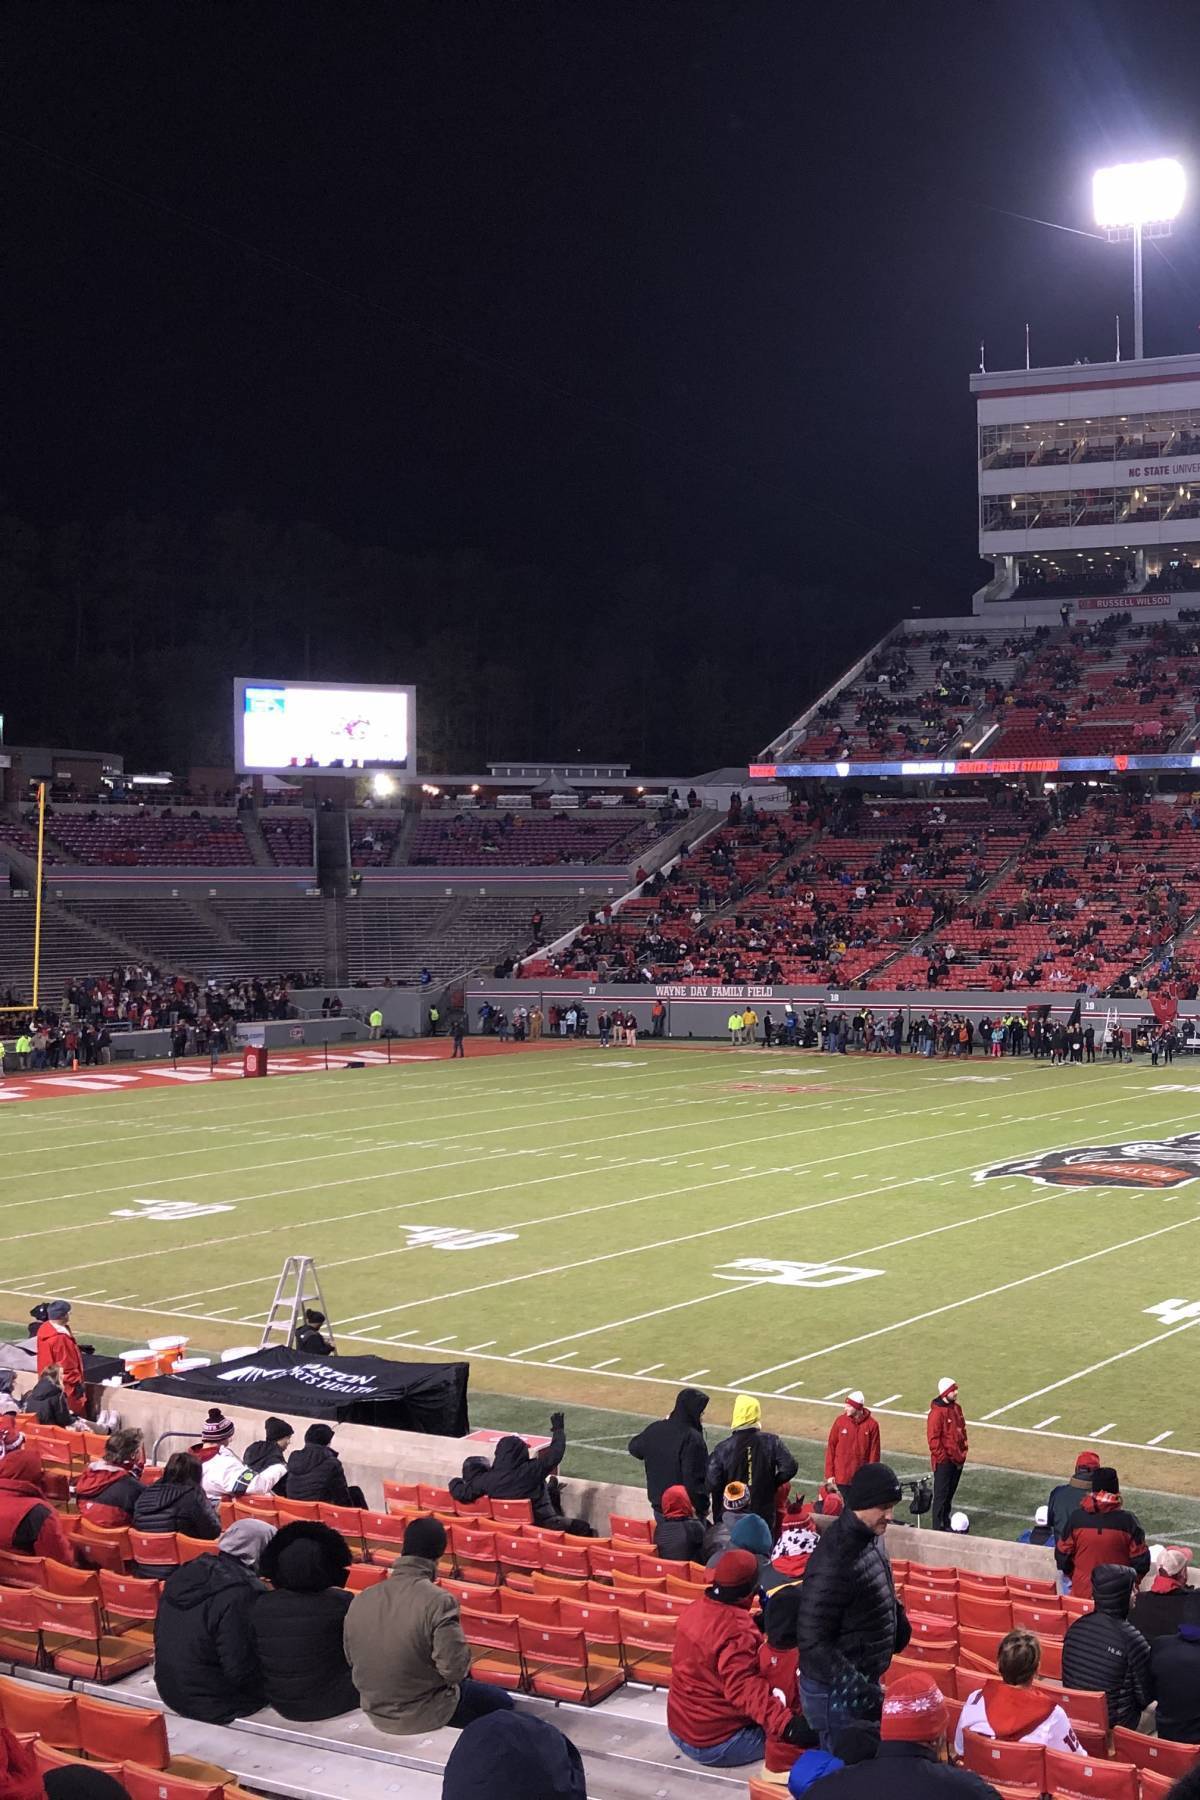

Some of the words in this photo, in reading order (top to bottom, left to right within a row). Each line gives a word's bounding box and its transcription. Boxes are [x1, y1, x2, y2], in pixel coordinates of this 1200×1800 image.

[1128, 466, 1142, 478] NC
[1144, 464, 1170, 477] STATE
[1097, 599, 1135, 608] RUSSELL
[1136, 596, 1170, 607] WILSON
[588, 986, 596, 995] 17
[655, 985, 687, 997] WAYNE
[690, 985, 709, 997] DAY
[711, 986, 745, 998] FAMILY
[747, 986, 773, 998] FIELD
